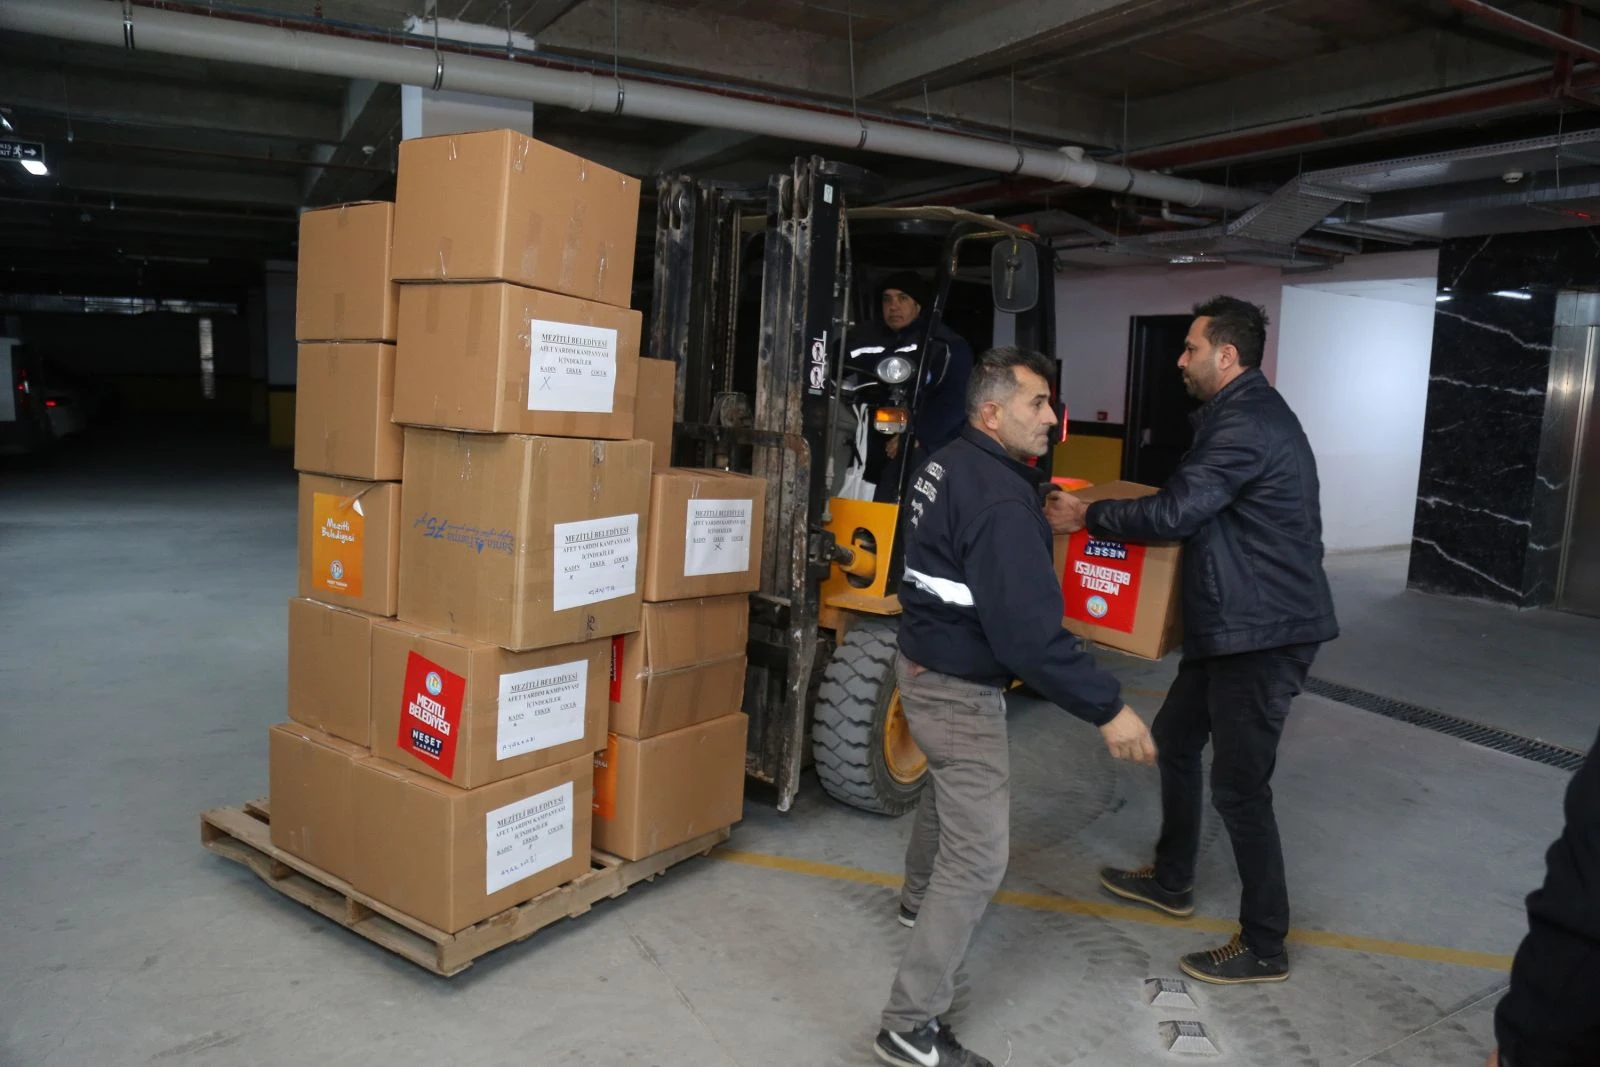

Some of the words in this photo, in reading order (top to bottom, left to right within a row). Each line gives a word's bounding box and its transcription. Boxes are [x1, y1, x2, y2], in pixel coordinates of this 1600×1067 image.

[541, 331, 569, 344] MEZİTLİ
[571, 335, 607, 348] BELEDİYESİ
[565, 530, 592, 543] MEZİTLİ
[594, 526, 629, 538] BELEDİYESİ
[562, 545, 576, 553] AFET
[1074, 560, 1131, 586] BELEDİYESİ
[1081, 575, 1120, 596] MEZİTLİ
[510, 679, 540, 693] MEZİTLİ
[540, 671, 577, 687] BELEDİYESİ
[416, 692, 446, 719] MEZİTLİ
[507, 694, 522, 702] AFET
[523, 689, 544, 699] YARDIM
[408, 702, 450, 736] BELEDİYESİ
[497, 809, 525, 828] MEZİTLİ
[526, 794, 563, 817] BELEDİYESİ
